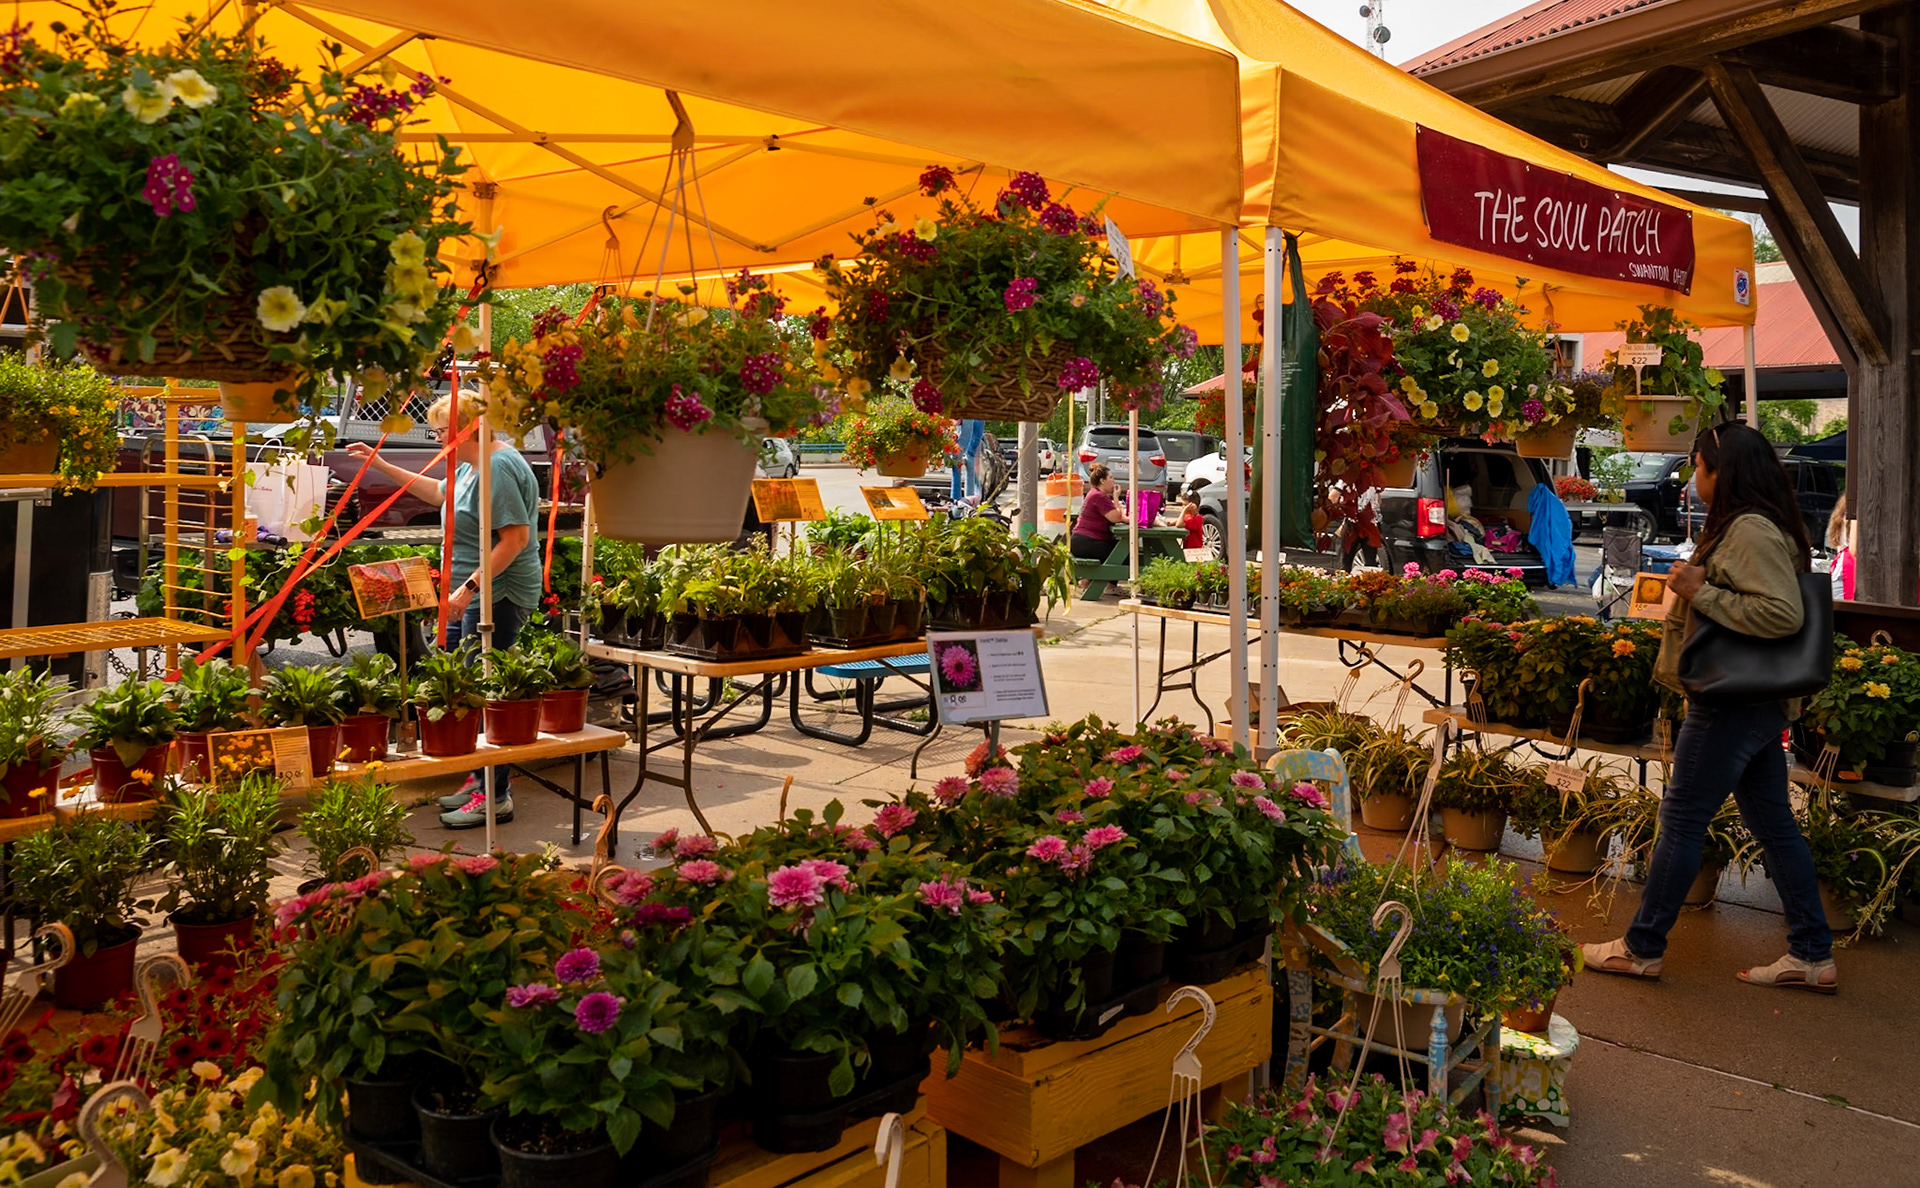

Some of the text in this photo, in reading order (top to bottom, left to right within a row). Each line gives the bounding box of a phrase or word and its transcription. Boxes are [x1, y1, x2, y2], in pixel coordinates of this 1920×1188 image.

[1474, 188, 1661, 256] THE SOUL PATCH
[1628, 262, 1670, 284] SWANTON
[1556, 778, 1571, 789] $22
